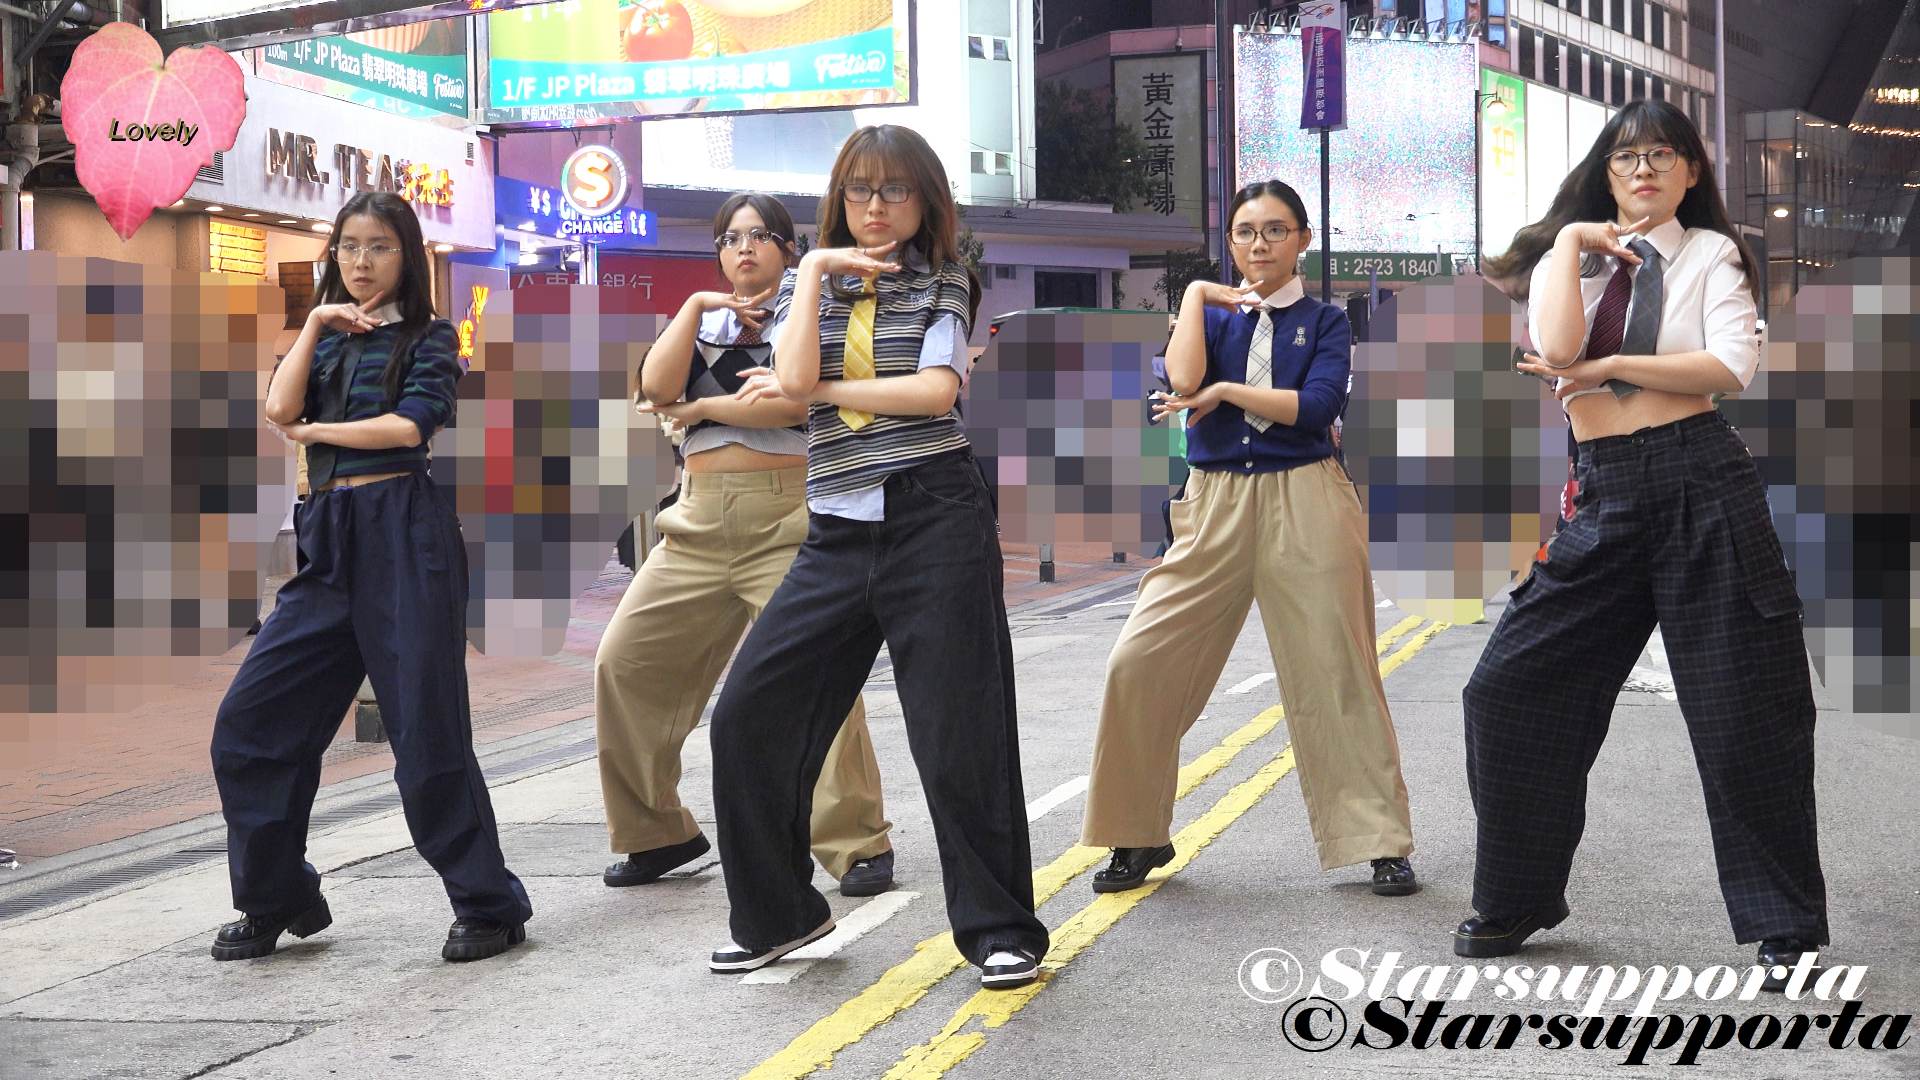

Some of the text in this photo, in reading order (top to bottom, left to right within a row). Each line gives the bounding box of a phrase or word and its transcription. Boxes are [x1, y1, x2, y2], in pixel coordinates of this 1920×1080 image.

[293, 40, 312, 65] 1/F
[313, 41, 328, 66] JP
[330, 45, 360, 76] Plaza
[502, 76, 537, 101] 1/F
[541, 74, 570, 99] JP
[574, 71, 635, 98] Plaza
[266, 127, 398, 194] MR. TEA
[561, 220, 624, 234] CHANGE
[1353, 258, 1394, 276] 2523
[1399, 259, 1438, 277] 1840
